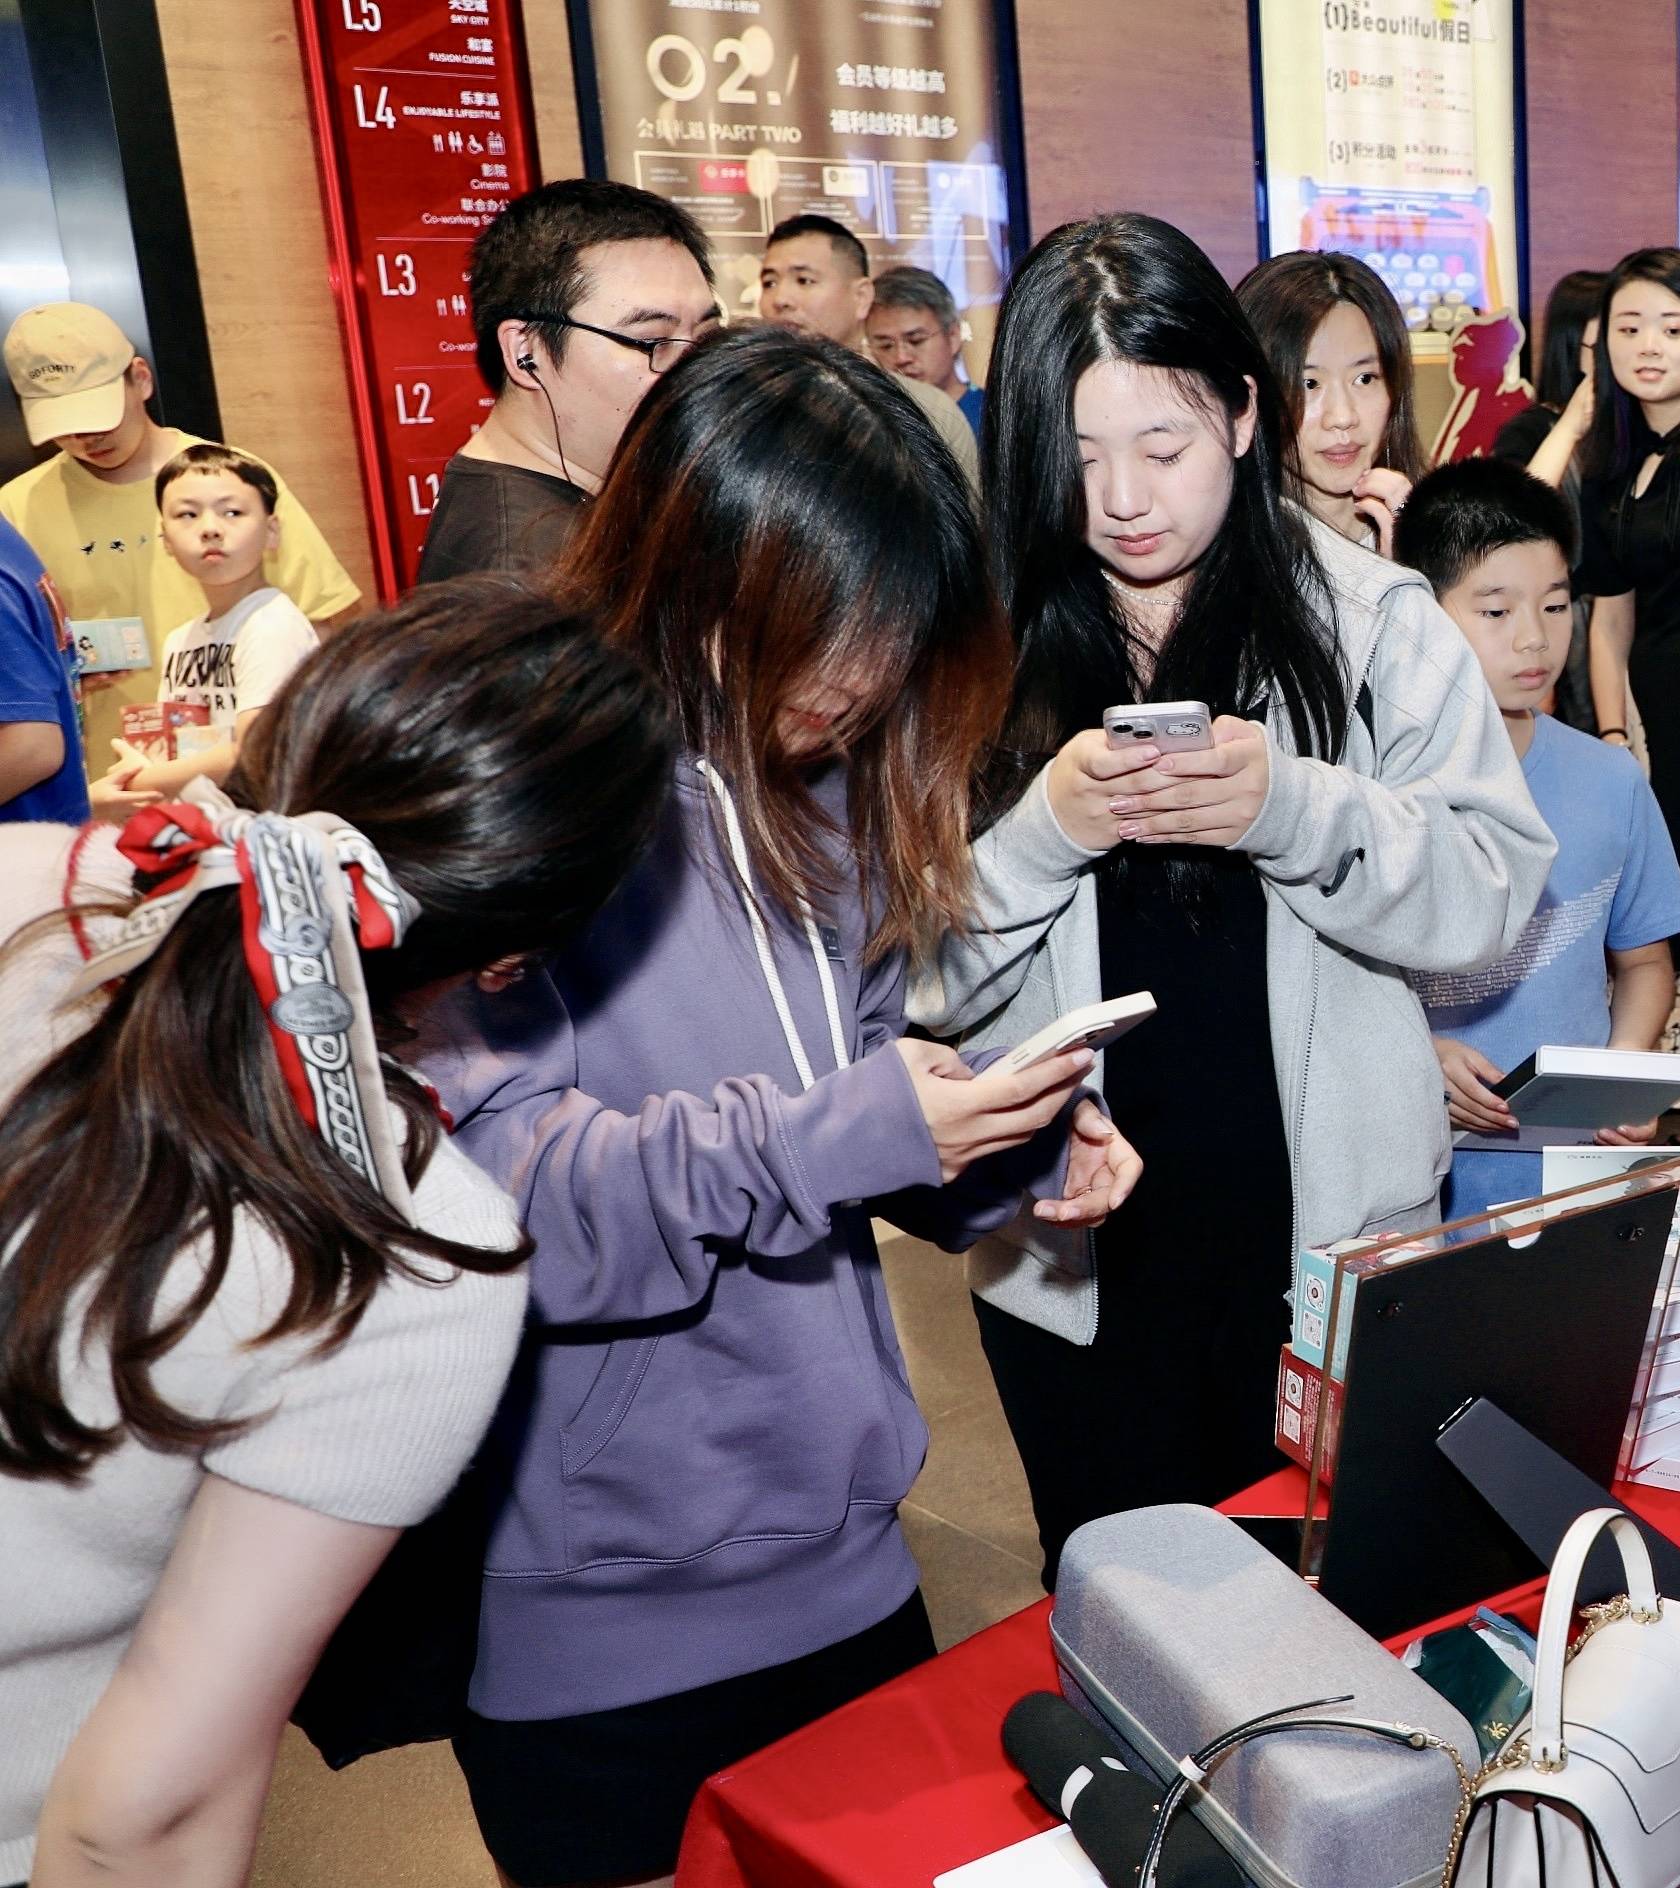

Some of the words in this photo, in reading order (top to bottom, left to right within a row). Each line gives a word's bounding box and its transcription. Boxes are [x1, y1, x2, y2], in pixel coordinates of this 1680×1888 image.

[342, 0, 382, 32] L5
[835, 62, 946, 94] 会员等级越高
[354, 84, 396, 129] L4
[402, 105, 454, 118] ENJOYABLE
[455, 107, 501, 120] LIFESTYLE
[708, 122, 757, 142] PART
[761, 125, 802, 144] TWO
[830, 108, 958, 140] 福利越好礼越多
[470, 178, 510, 191] Cinema
[421, 213, 480, 227] Co-working
[377, 254, 416, 296] L3
[395, 382, 435, 425] L2
